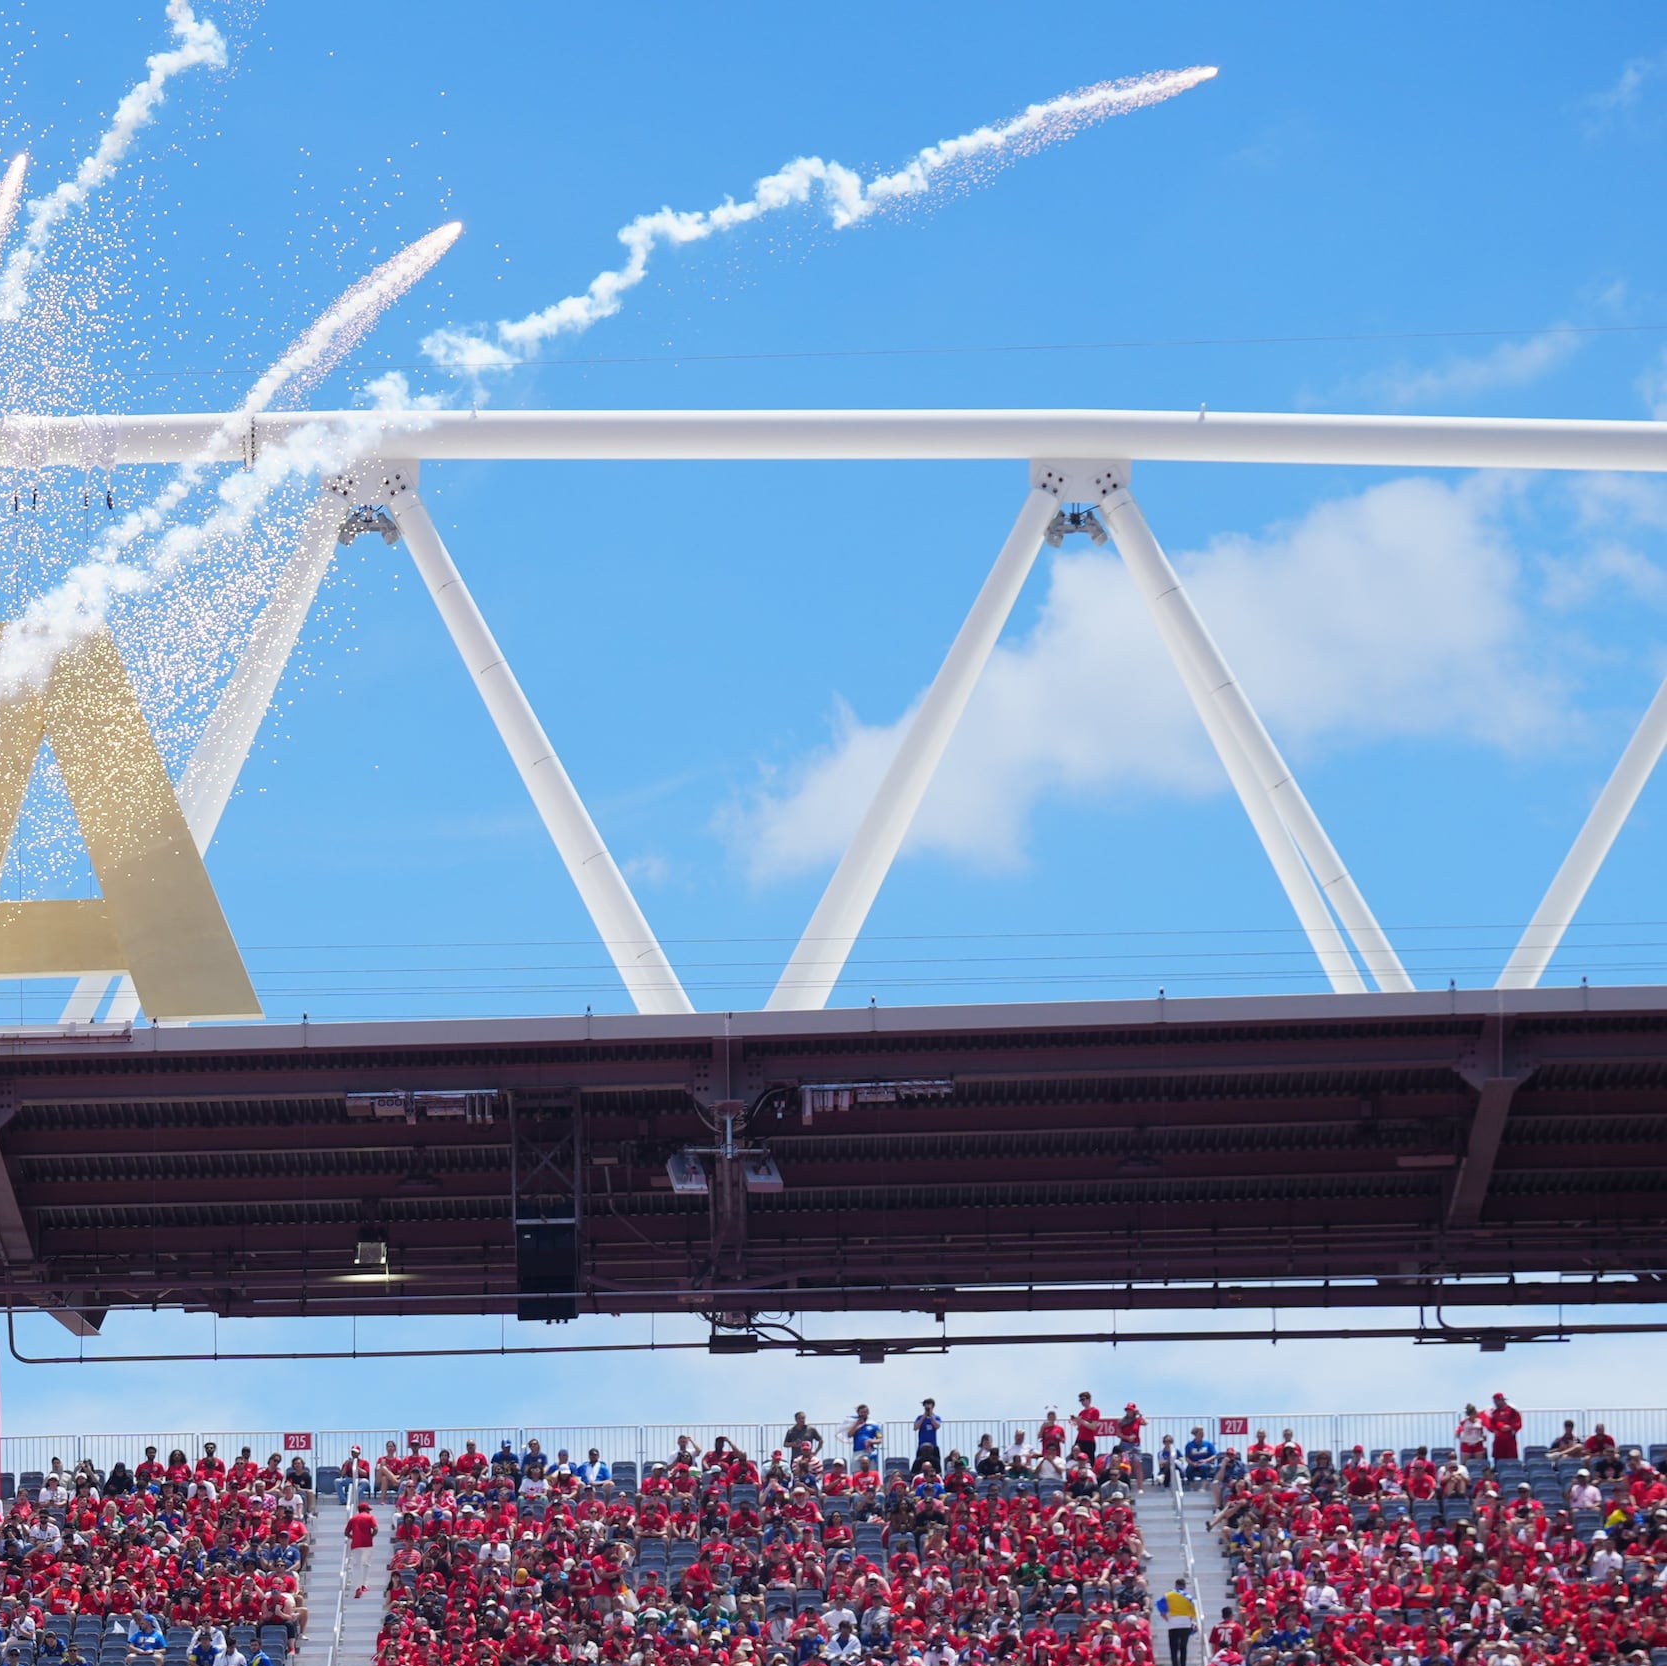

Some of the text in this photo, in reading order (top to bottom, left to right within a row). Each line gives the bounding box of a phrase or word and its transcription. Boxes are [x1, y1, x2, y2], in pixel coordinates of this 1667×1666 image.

[1097, 1421, 1115, 1435] 216
[1226, 1420, 1243, 1433] 217
[289, 1435, 306, 1448] 215
